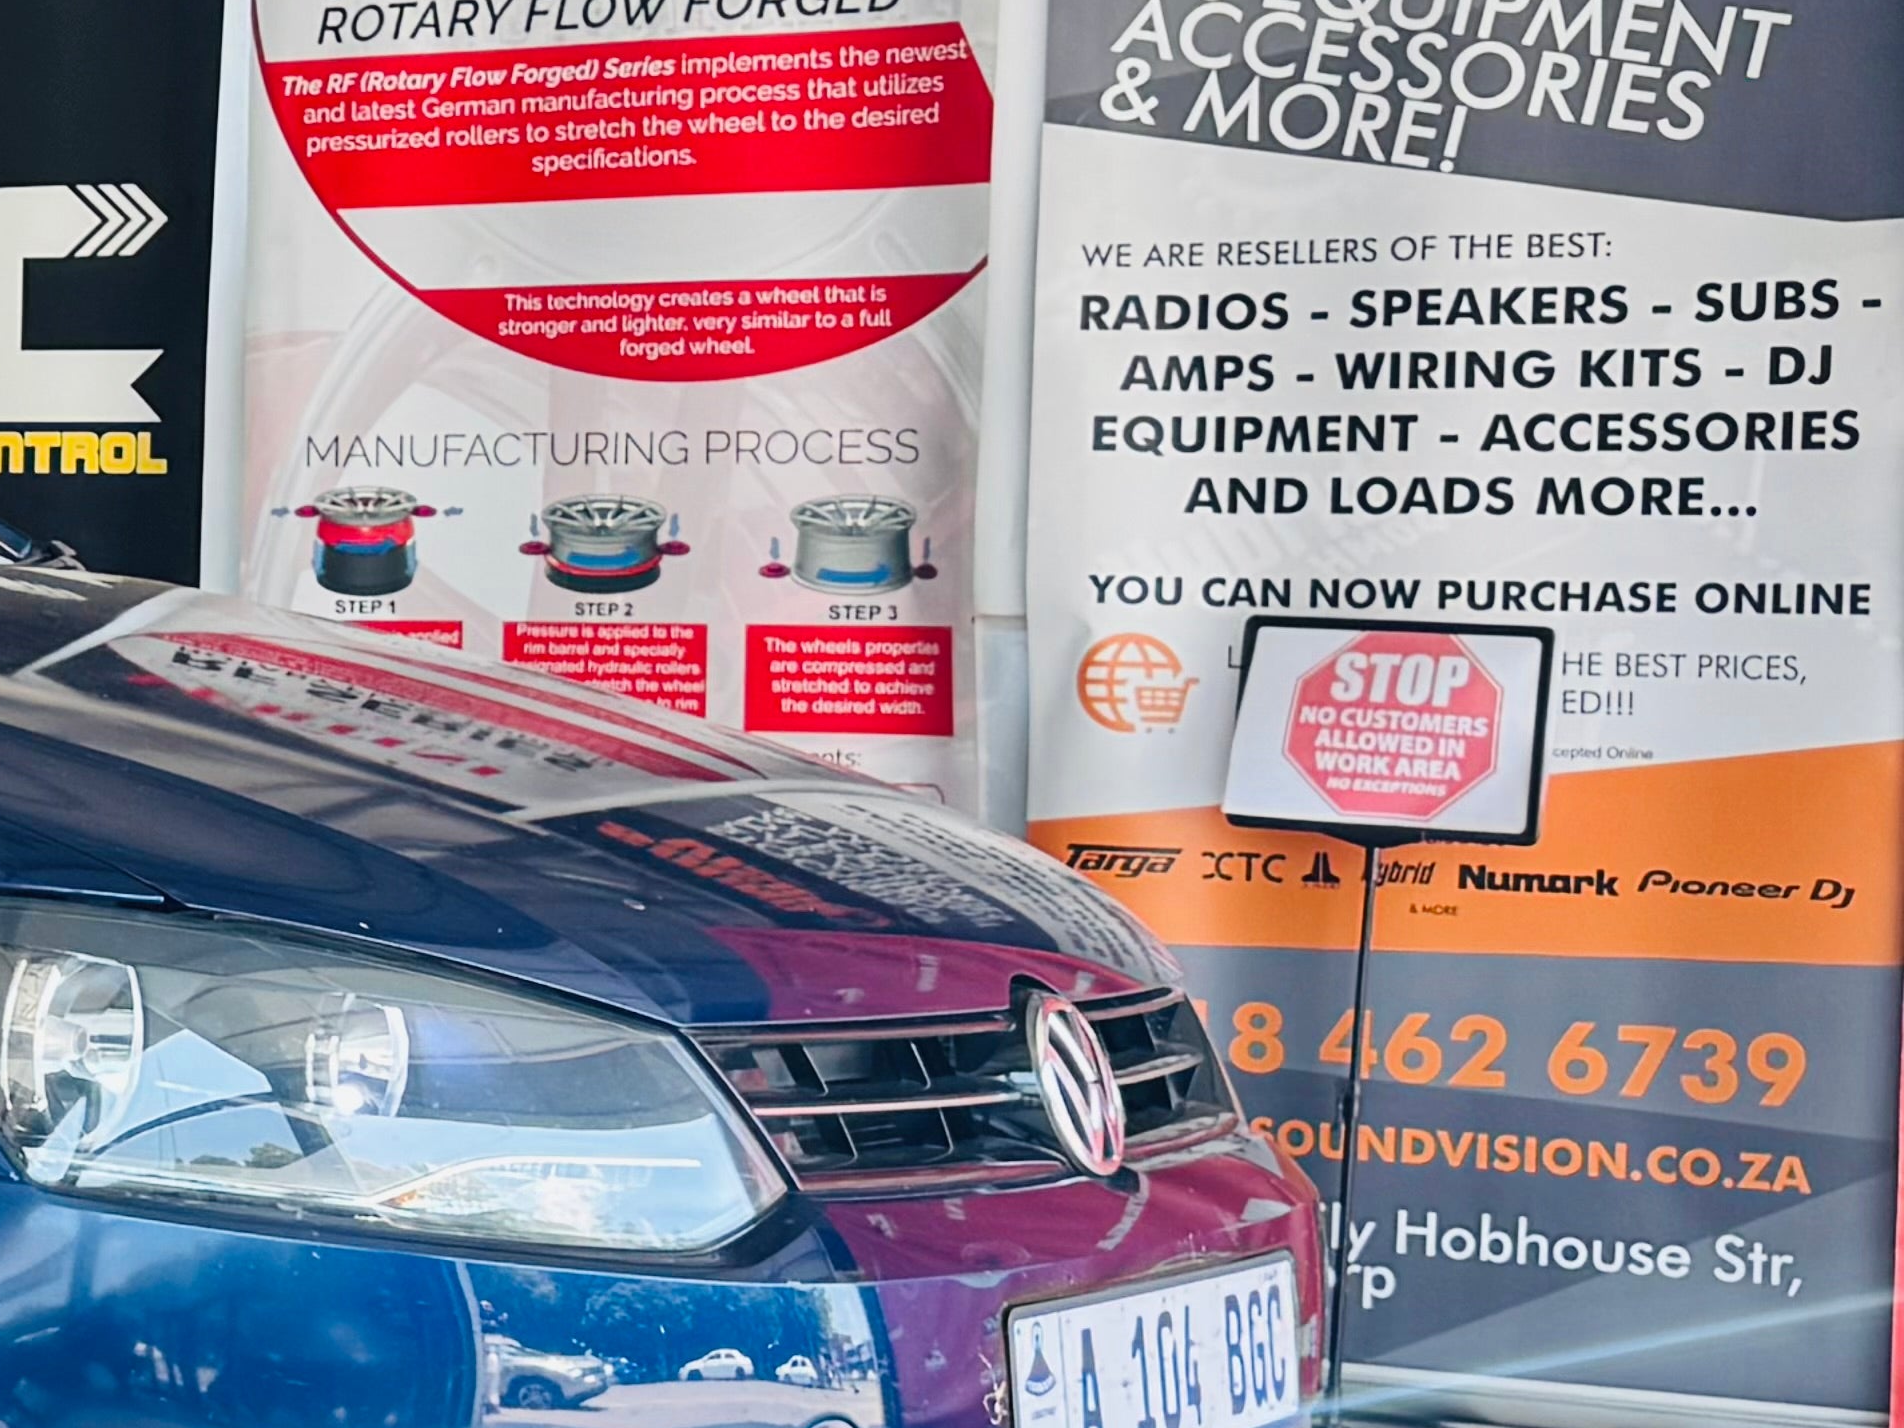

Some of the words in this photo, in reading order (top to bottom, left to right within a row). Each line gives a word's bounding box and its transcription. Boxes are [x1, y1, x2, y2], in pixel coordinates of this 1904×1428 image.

[283, 76, 321, 96] The
[327, 73, 357, 94] RF
[360, 71, 446, 93] (Rotary
[450, 66, 507, 89] Flow
[511, 59, 599, 87] Forged)
[603, 56, 675, 78] Series
[682, 49, 832, 79] implements
[839, 46, 880, 68] the
[886, 39, 967, 65] newest
[304, 103, 345, 124] and
[352, 99, 416, 122] latest
[422, 96, 515, 119] German
[522, 84, 693, 113] manufacturing
[700, 81, 800, 108] process
[807, 77, 857, 100] that
[864, 73, 944, 96] utilizes
[1100, 55, 1159, 128] &
[1183, 70, 1469, 172] MORE!
[307, 127, 440, 157] pressurized
[446, 124, 519, 147] rollers
[526, 125, 549, 143] to
[555, 117, 635, 143] stretch
[643, 114, 682, 137] the
[688, 110, 766, 134] wheel
[771, 111, 797, 131] to
[804, 108, 843, 130] the
[852, 102, 940, 128] desired
[533, 145, 696, 176] specifications.
[1081, 244, 1132, 268] WE
[1143, 244, 1205, 268] ARE
[1216, 238, 1377, 265] RESELLERS
[1389, 236, 1437, 263] OF
[1447, 234, 1517, 260] THE
[1527, 232, 1612, 259] BEST:
[504, 294, 542, 310] This
[547, 292, 655, 312] technology
[659, 290, 733, 307] creates
[739, 292, 752, 304] a
[756, 286, 819, 305] wheel
[825, 286, 866, 302] that
[870, 284, 886, 302] is
[1078, 292, 1290, 331] RADIOS
[1349, 284, 1629, 329] SPEAKERS
[1694, 279, 1841, 325] SUBS
[1120, 354, 1275, 393] AMPS
[1336, 350, 1556, 391] WIRING
[1579, 346, 1702, 388] KITS
[1768, 345, 1833, 387] DJ
[306, 429, 690, 470] MANUFACTURING
[704, 428, 919, 466] PROCESS
[1092, 415, 1418, 457] EQUIPMENT
[1481, 409, 1861, 454] ACCESSORIES
[1185, 477, 1309, 516] AND
[1330, 475, 1515, 514] LOADS
[1536, 477, 1757, 517] MORE...
[336, 600, 382, 614] STEP
[389, 600, 395, 614] 1
[576, 603, 619, 616] STEP
[624, 603, 634, 616] 2
[829, 605, 881, 620] STEP
[888, 606, 898, 620] 3
[1088, 574, 1183, 606] YOU
[1201, 576, 1291, 609] CAN
[1309, 578, 1420, 610] NOW
[1437, 579, 1676, 613] PURCHASE
[1694, 580, 1870, 615] ONLINE
[1330, 651, 1470, 707] STOP
[1614, 652, 1687, 680] BEST
[1698, 652, 1807, 686] PRICES,
[1300, 706, 1336, 724] NO
[1340, 708, 1488, 737] CUSTOMERS
[1314, 731, 1433, 755] ALLOWED
[1438, 738, 1466, 758] IN
[1315, 751, 1391, 776] WORK
[1394, 756, 1461, 781] AREA
[1327, 777, 1350, 790] NO
[1353, 778, 1446, 797] EXCEPTIONS
[1067, 843, 1183, 878] Targa
[1457, 864, 1619, 897] Numark
[1637, 869, 1800, 899] Pioneer
[1318, 1008, 1508, 1090] 462
[1546, 1021, 1807, 1107] 6739
[1395, 1210, 1691, 1277] Hobhouse
[1713, 1235, 1803, 1296] Str,
[1225, 1284, 1285, 1415] BGC
